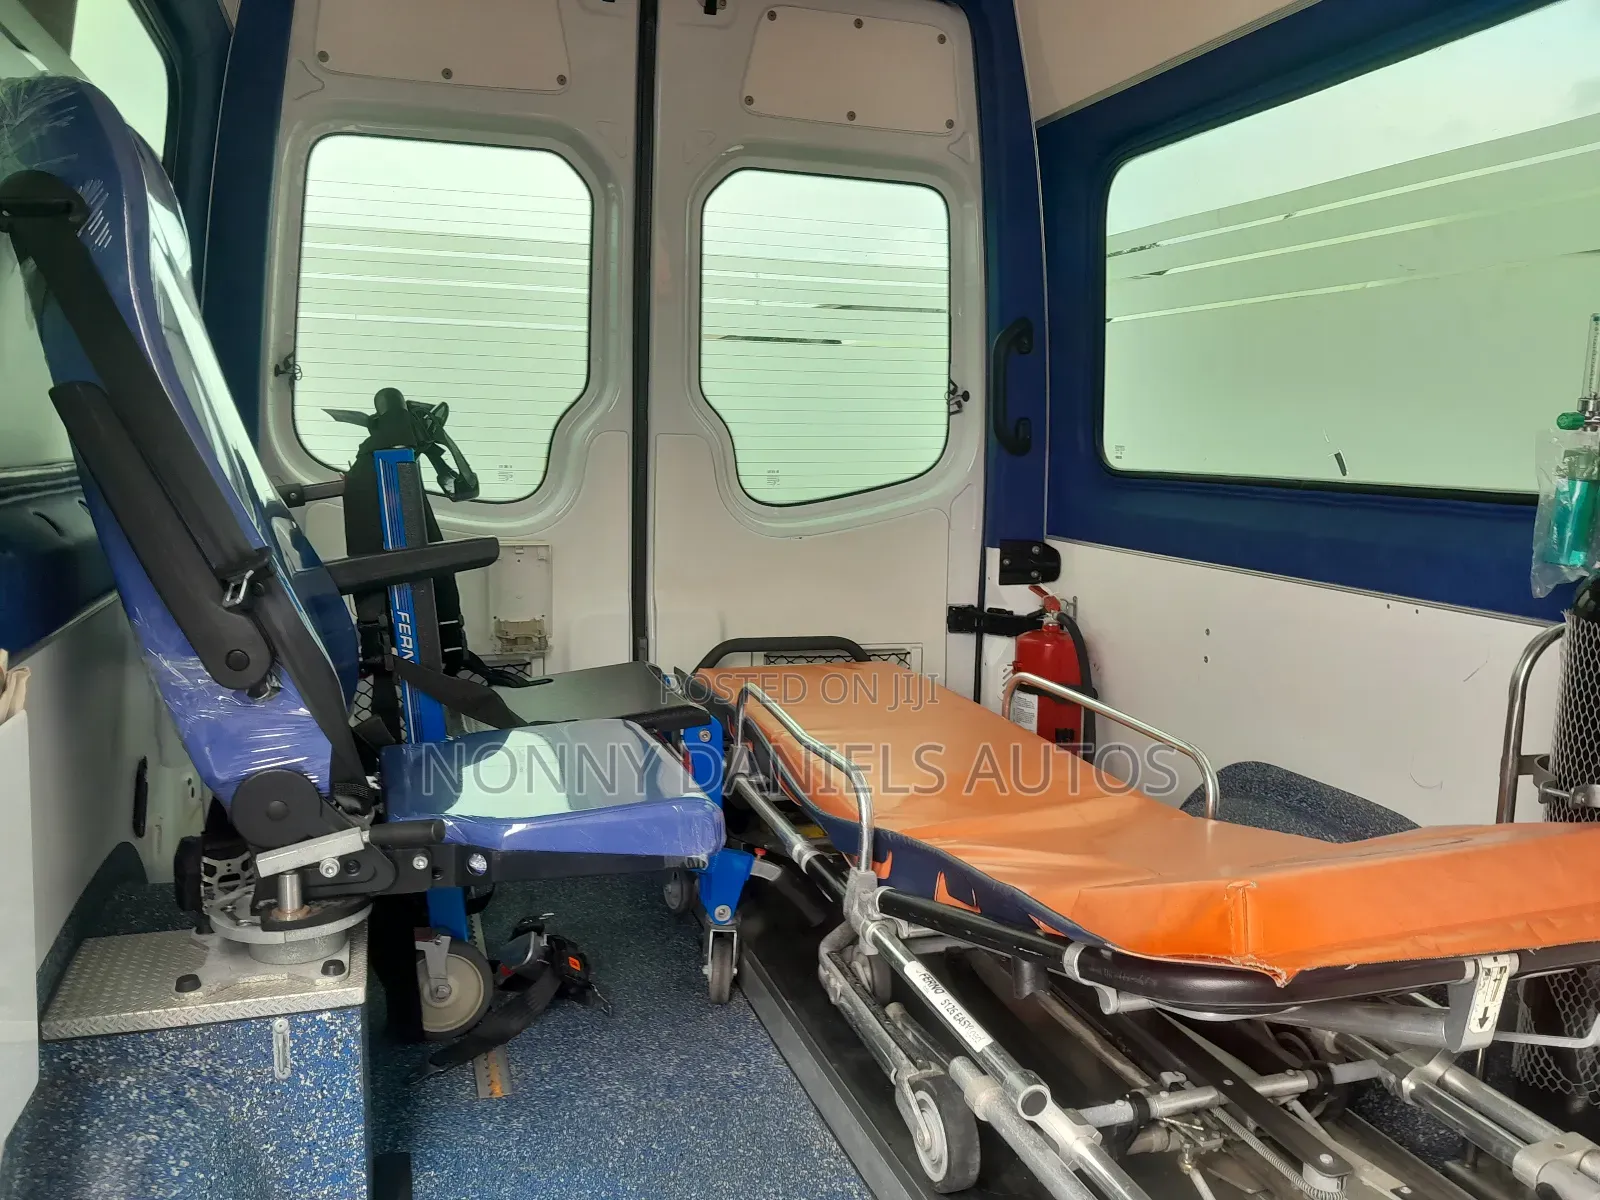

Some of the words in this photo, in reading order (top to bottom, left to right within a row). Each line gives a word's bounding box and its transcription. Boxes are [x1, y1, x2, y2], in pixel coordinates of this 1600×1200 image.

[396, 611, 416, 664] FERN
[919, 973, 945, 994] FERNO
[941, 999, 959, 1015] 5126
